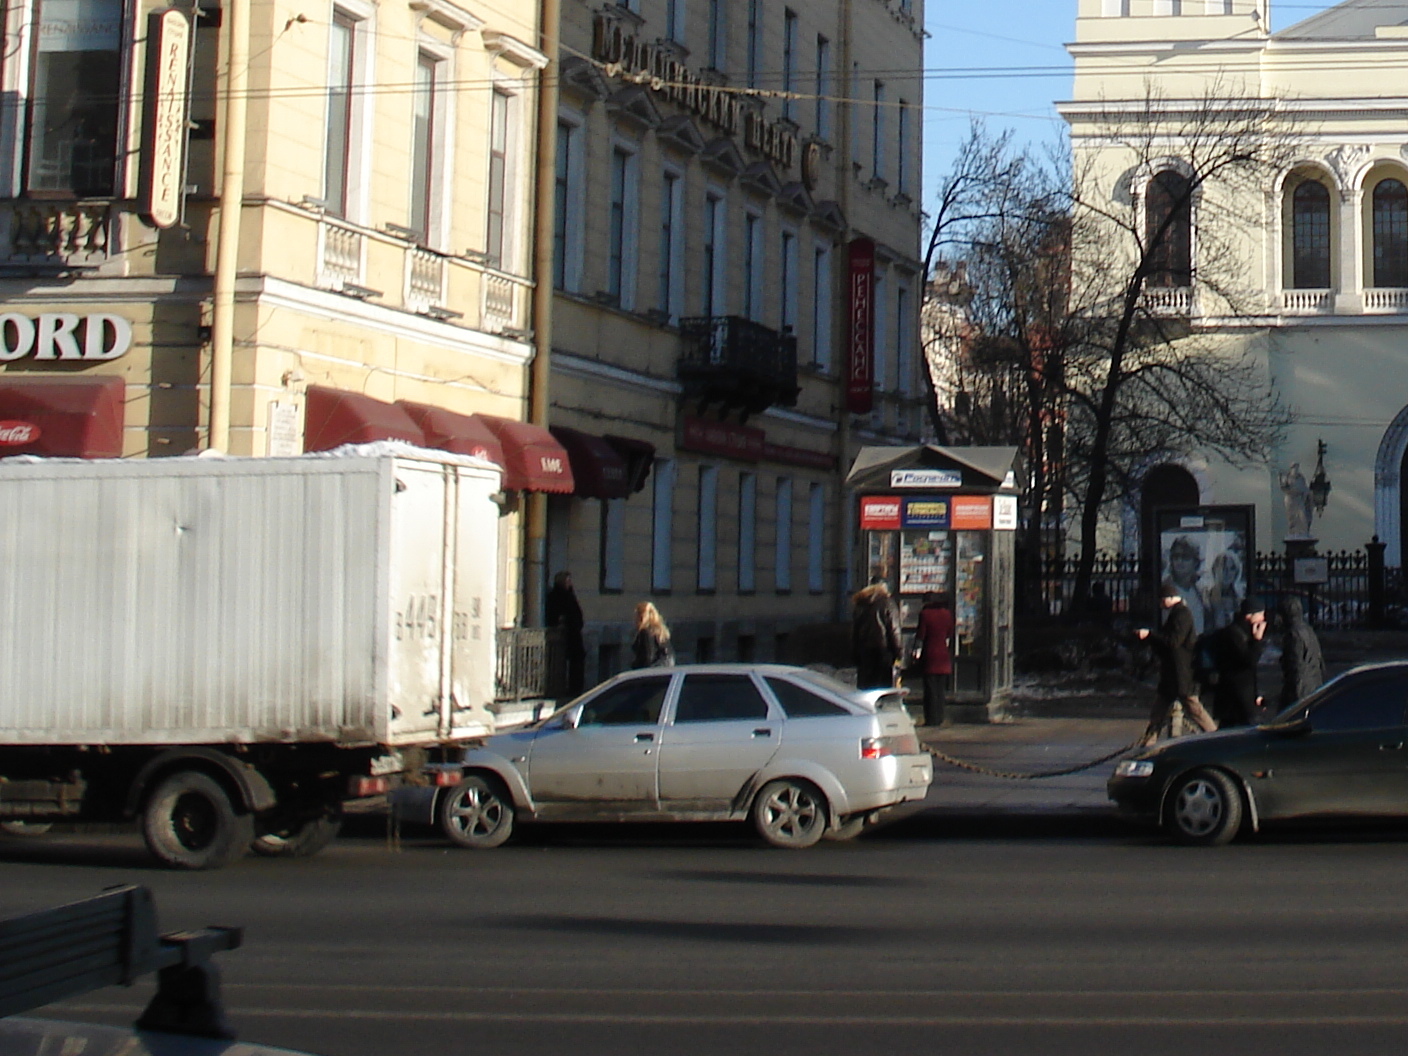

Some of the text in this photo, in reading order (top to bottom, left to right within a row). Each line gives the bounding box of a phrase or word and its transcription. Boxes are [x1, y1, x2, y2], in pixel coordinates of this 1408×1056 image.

[160, 41, 179, 203] RENAISSANCE
[0, 312, 133, 361] ORD
[854, 273, 867, 379] РЕНЕССАНС
